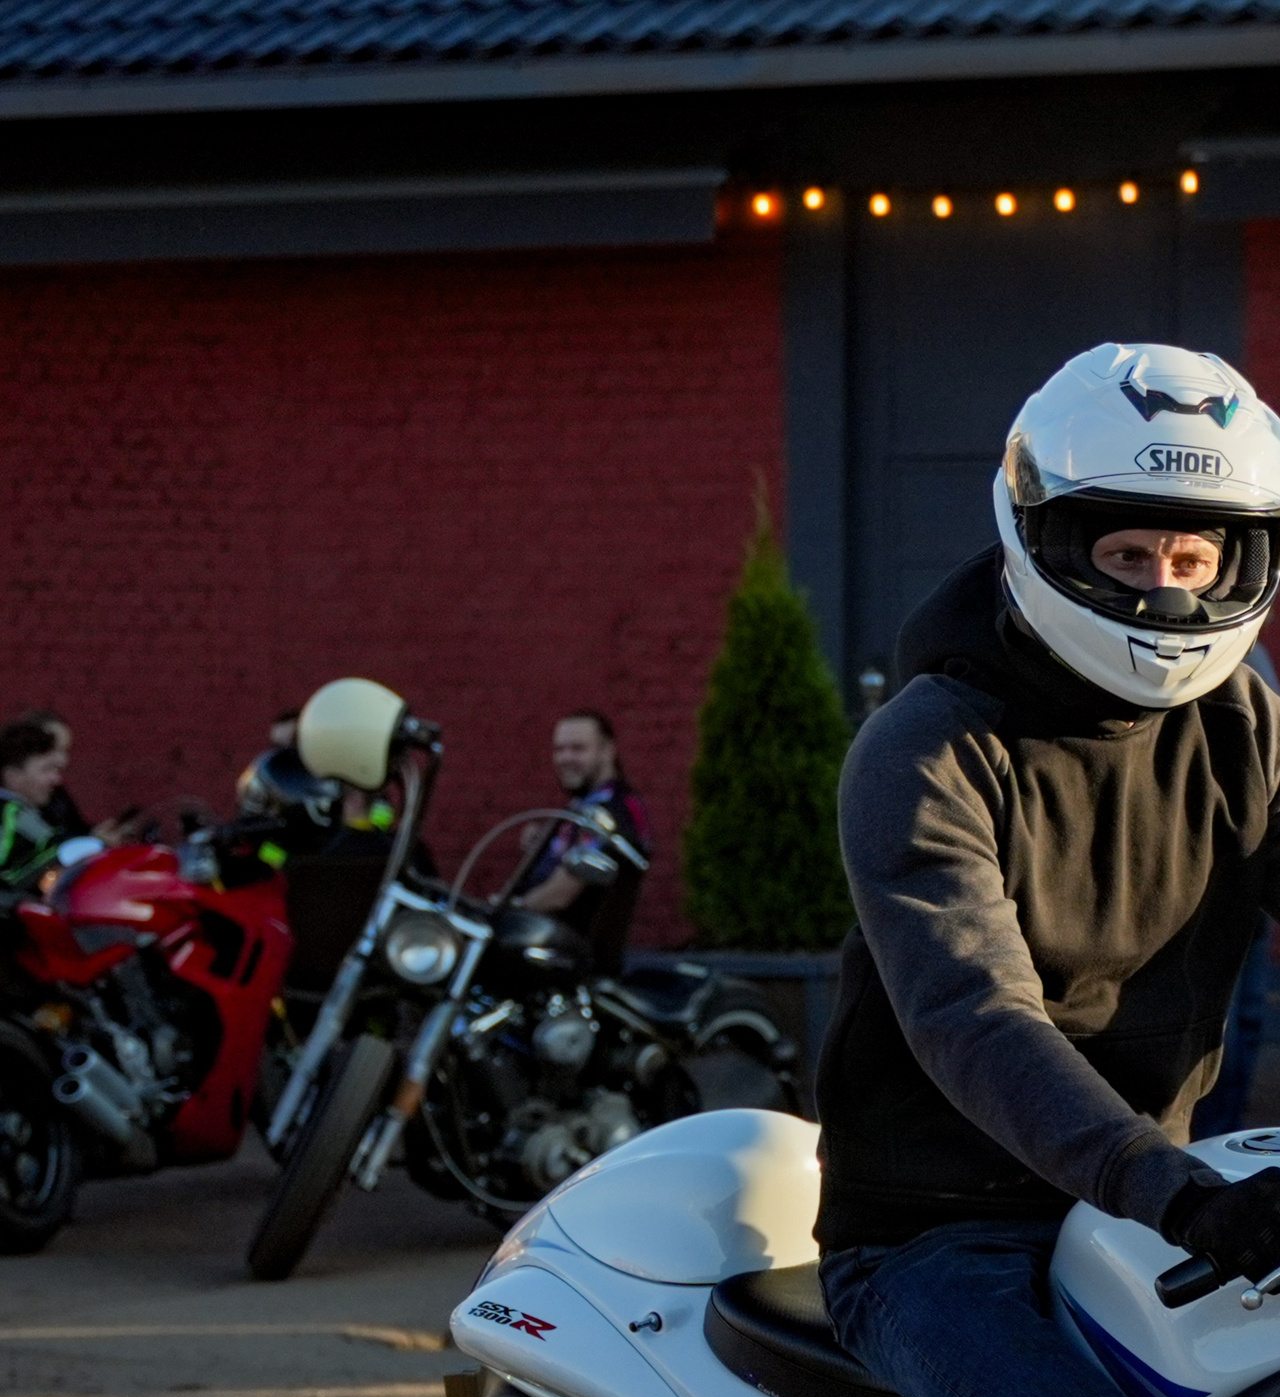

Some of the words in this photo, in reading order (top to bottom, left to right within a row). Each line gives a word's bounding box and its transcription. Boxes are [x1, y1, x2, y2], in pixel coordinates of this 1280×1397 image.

[1149, 449, 1221, 476] SHOEI
[467, 1308, 513, 1325] 1300
[478, 1300, 518, 1318] GSX
[509, 1312, 557, 1342] R
